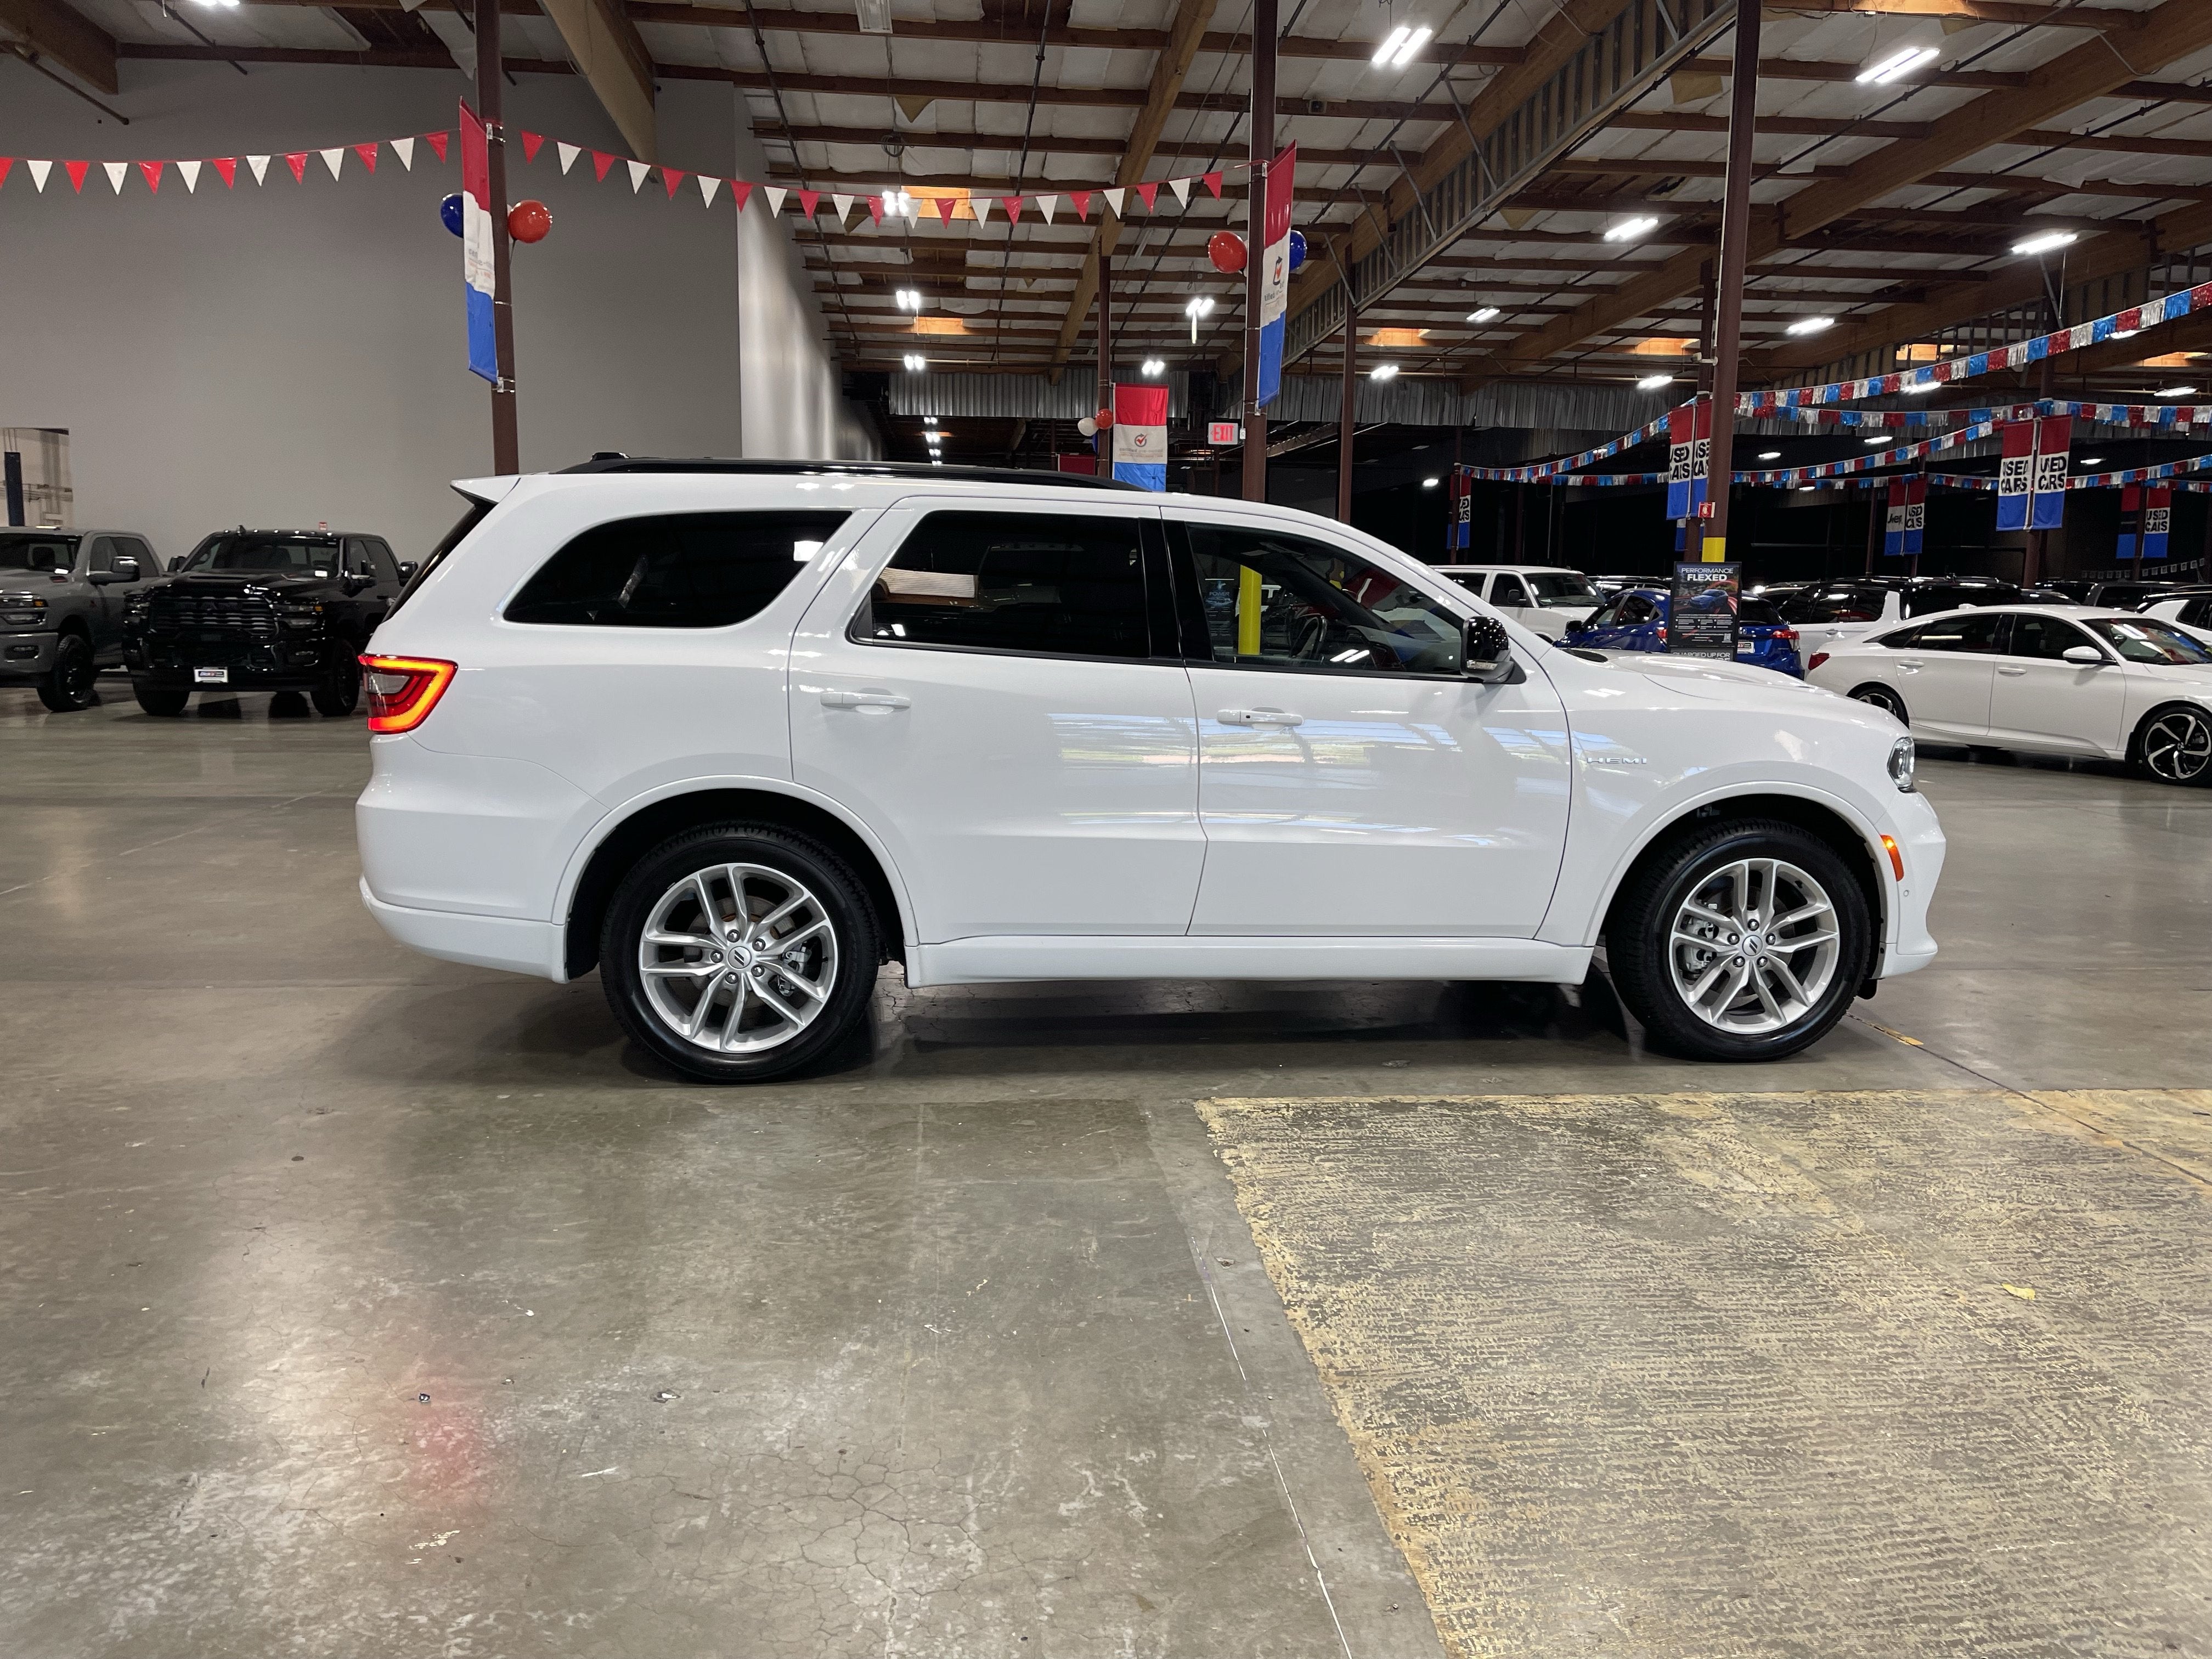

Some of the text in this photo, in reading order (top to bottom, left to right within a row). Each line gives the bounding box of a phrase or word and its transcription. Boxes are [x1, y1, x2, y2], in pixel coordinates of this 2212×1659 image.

[1214, 425, 1234, 442] EXIT
[1696, 442, 1709, 459] SE
[1670, 463, 1690, 480] AS
[2040, 456, 2067, 473] UED
[1909, 505, 1922, 517] USD
[1906, 517, 1922, 528] CAS
[1687, 573, 1728, 582] FLEXED
